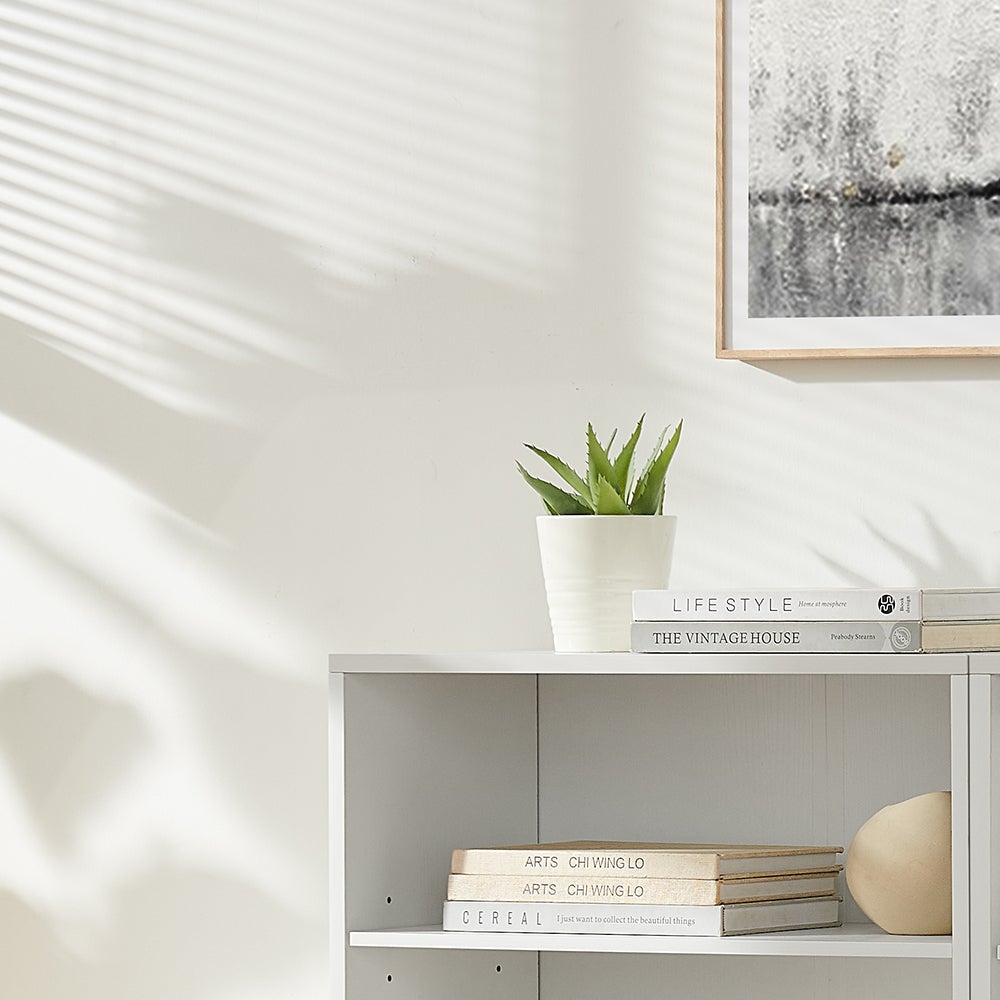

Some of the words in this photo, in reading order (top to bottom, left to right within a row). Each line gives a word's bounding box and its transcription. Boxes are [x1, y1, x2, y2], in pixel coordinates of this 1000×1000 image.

[798, 600, 813, 608] Home
[653, 632, 682, 645] THE
[686, 632, 748, 645] VINTAGE
[750, 631, 801, 645] HOUSE
[830, 633, 854, 641] Peabody
[854, 633, 876, 641] Stearns
[524, 856, 558, 868] ARTS
[568, 856, 589, 868] CHI
[591, 857, 625, 869] WING
[628, 857, 645, 869] LO
[522, 883, 557, 896] ARTS
[567, 884, 588, 896] CHI
[590, 885, 624, 897] WING
[627, 885, 644, 897] LO
[462, 910, 543, 926] CEREAL
[561, 915, 575, 924] just
[575, 916, 593, 924] want
[603, 915, 626, 924] collect
[627, 915, 639, 924] the
[640, 916, 672, 925] beautiful
[673, 916, 696, 926] things
